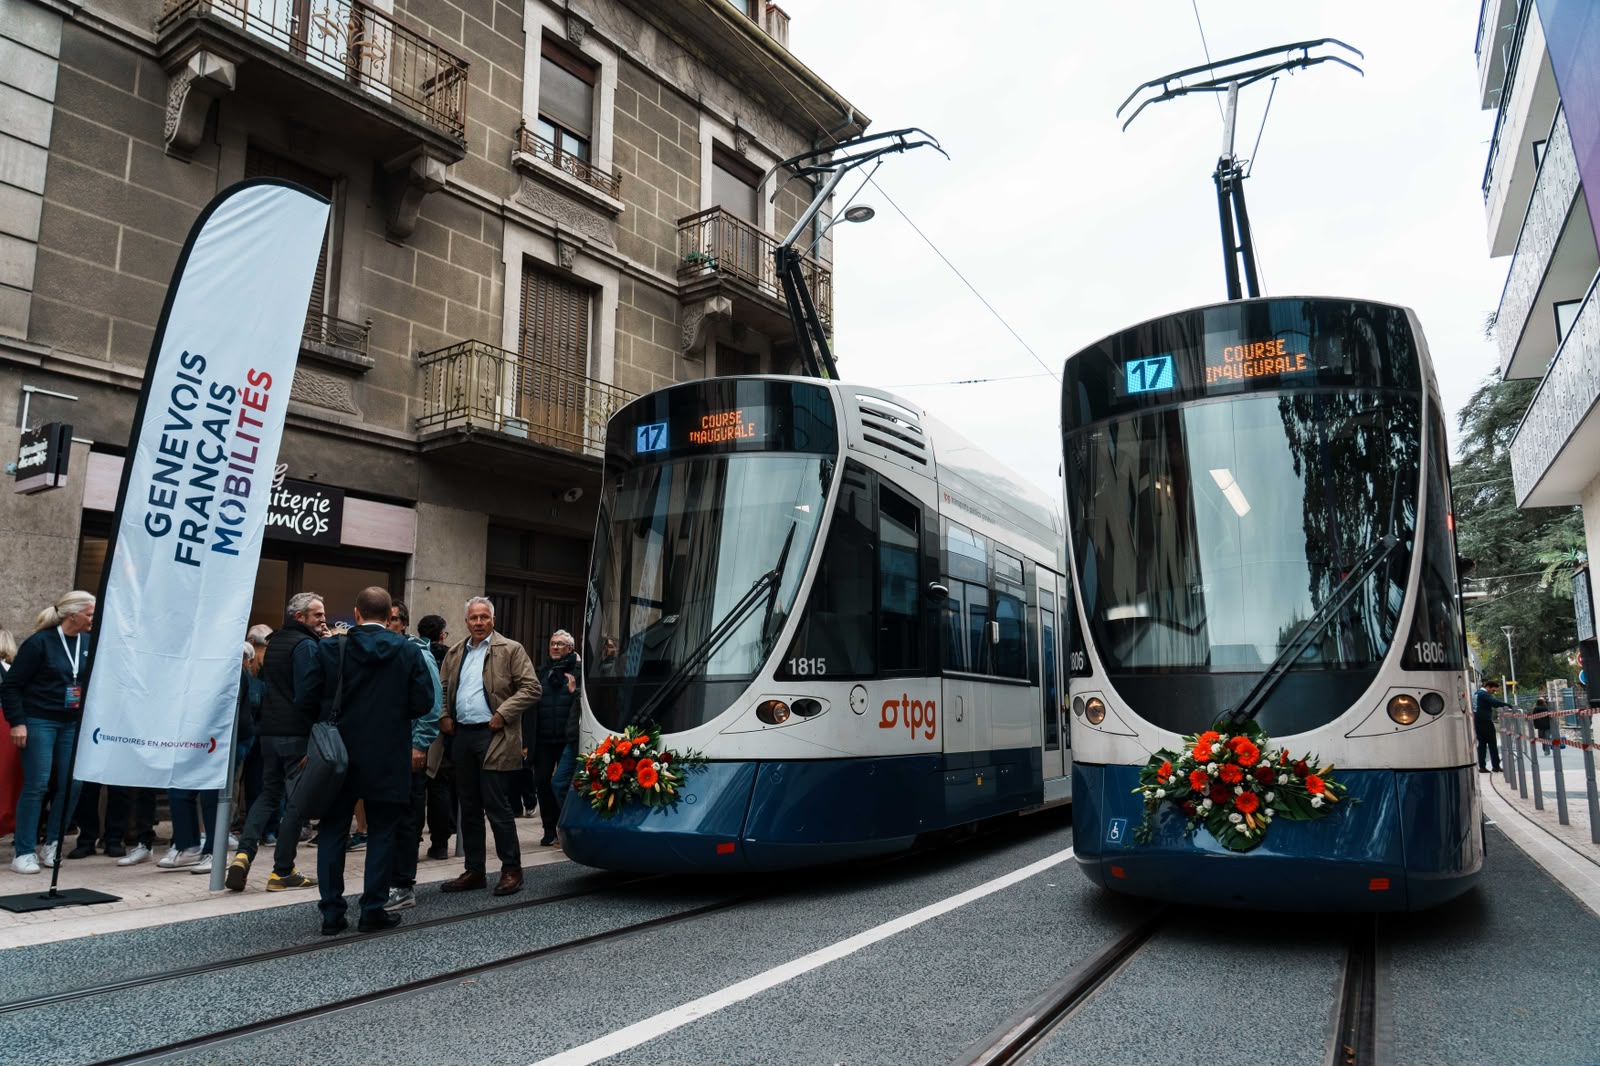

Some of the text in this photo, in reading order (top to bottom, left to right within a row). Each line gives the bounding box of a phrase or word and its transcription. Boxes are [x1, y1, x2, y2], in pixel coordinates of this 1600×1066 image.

[1223, 338, 1286, 363] COURSE
[1132, 358, 1167, 390] 17
[1206, 353, 1307, 384] INAUGURALE
[701, 410, 743, 430] COURSE
[145, 350, 207, 538] GENEVOIS
[639, 424, 665, 450] 17
[174, 381, 237, 567] FRANÇAIS
[211, 367, 273, 556] MOBILITÉS
[269, 486, 331, 513] iterie
[265, 508, 329, 537] mi(e)s
[1414, 641, 1445, 664] 1806
[788, 657, 826, 676] 1815
[147, 739, 159, 747] EN
